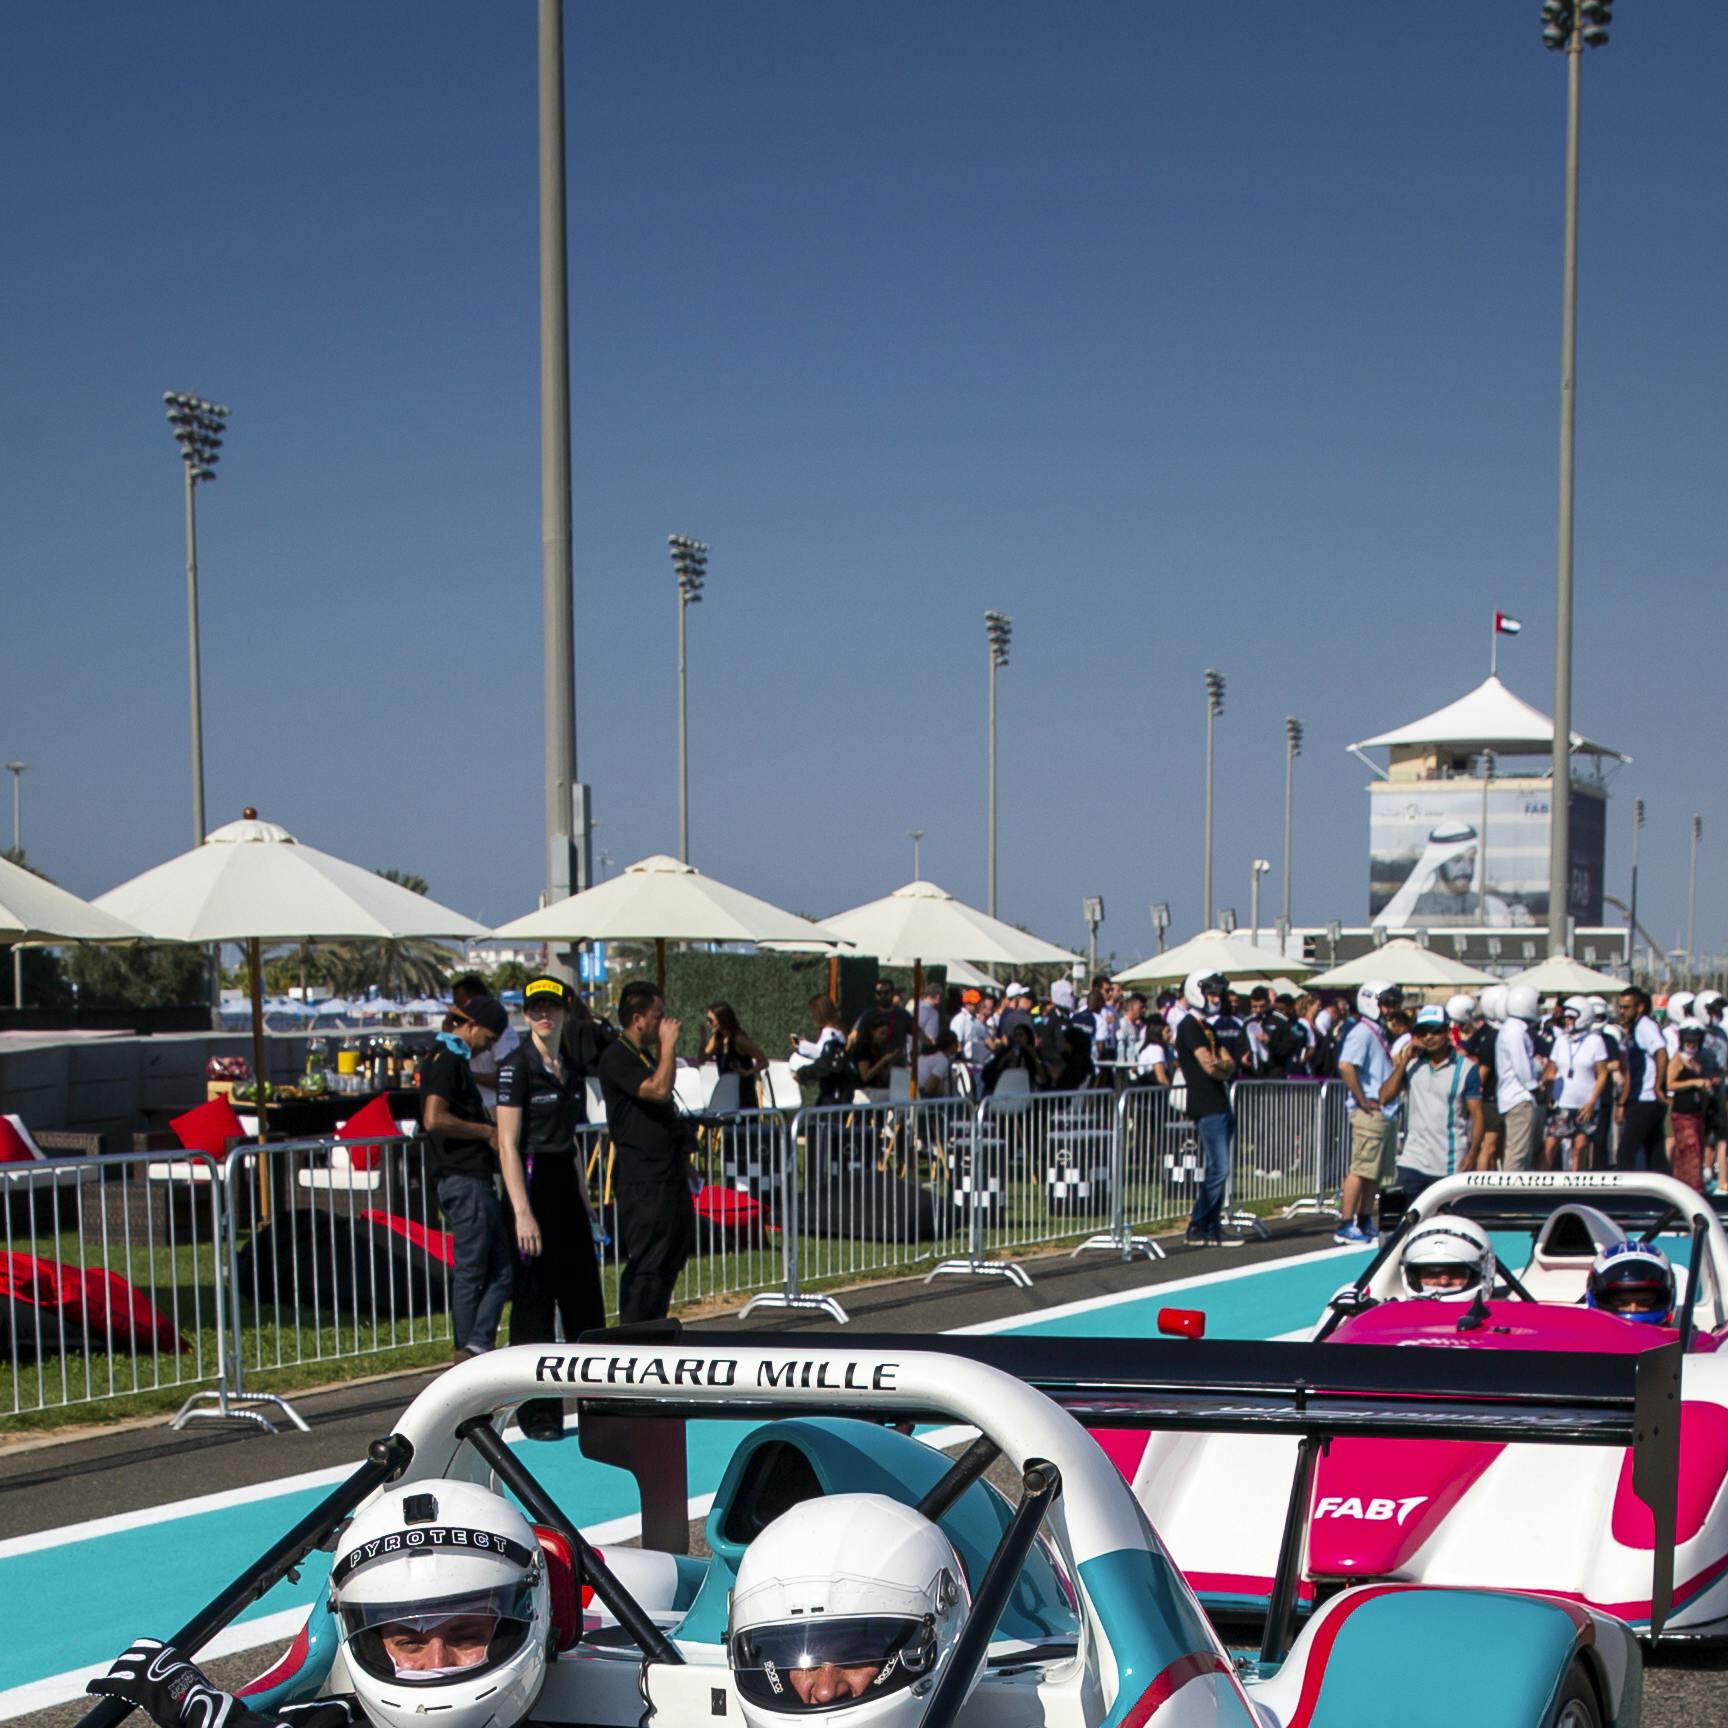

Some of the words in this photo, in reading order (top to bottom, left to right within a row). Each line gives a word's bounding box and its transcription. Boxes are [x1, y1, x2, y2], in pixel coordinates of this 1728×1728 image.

[1467, 1175, 1555, 1187] RICHARD
[1563, 1175, 1623, 1187] MILLE
[535, 1356, 738, 1386] RICHARD
[757, 1360, 899, 1391] MILLE
[351, 1530, 508, 1568] PYROTECT
